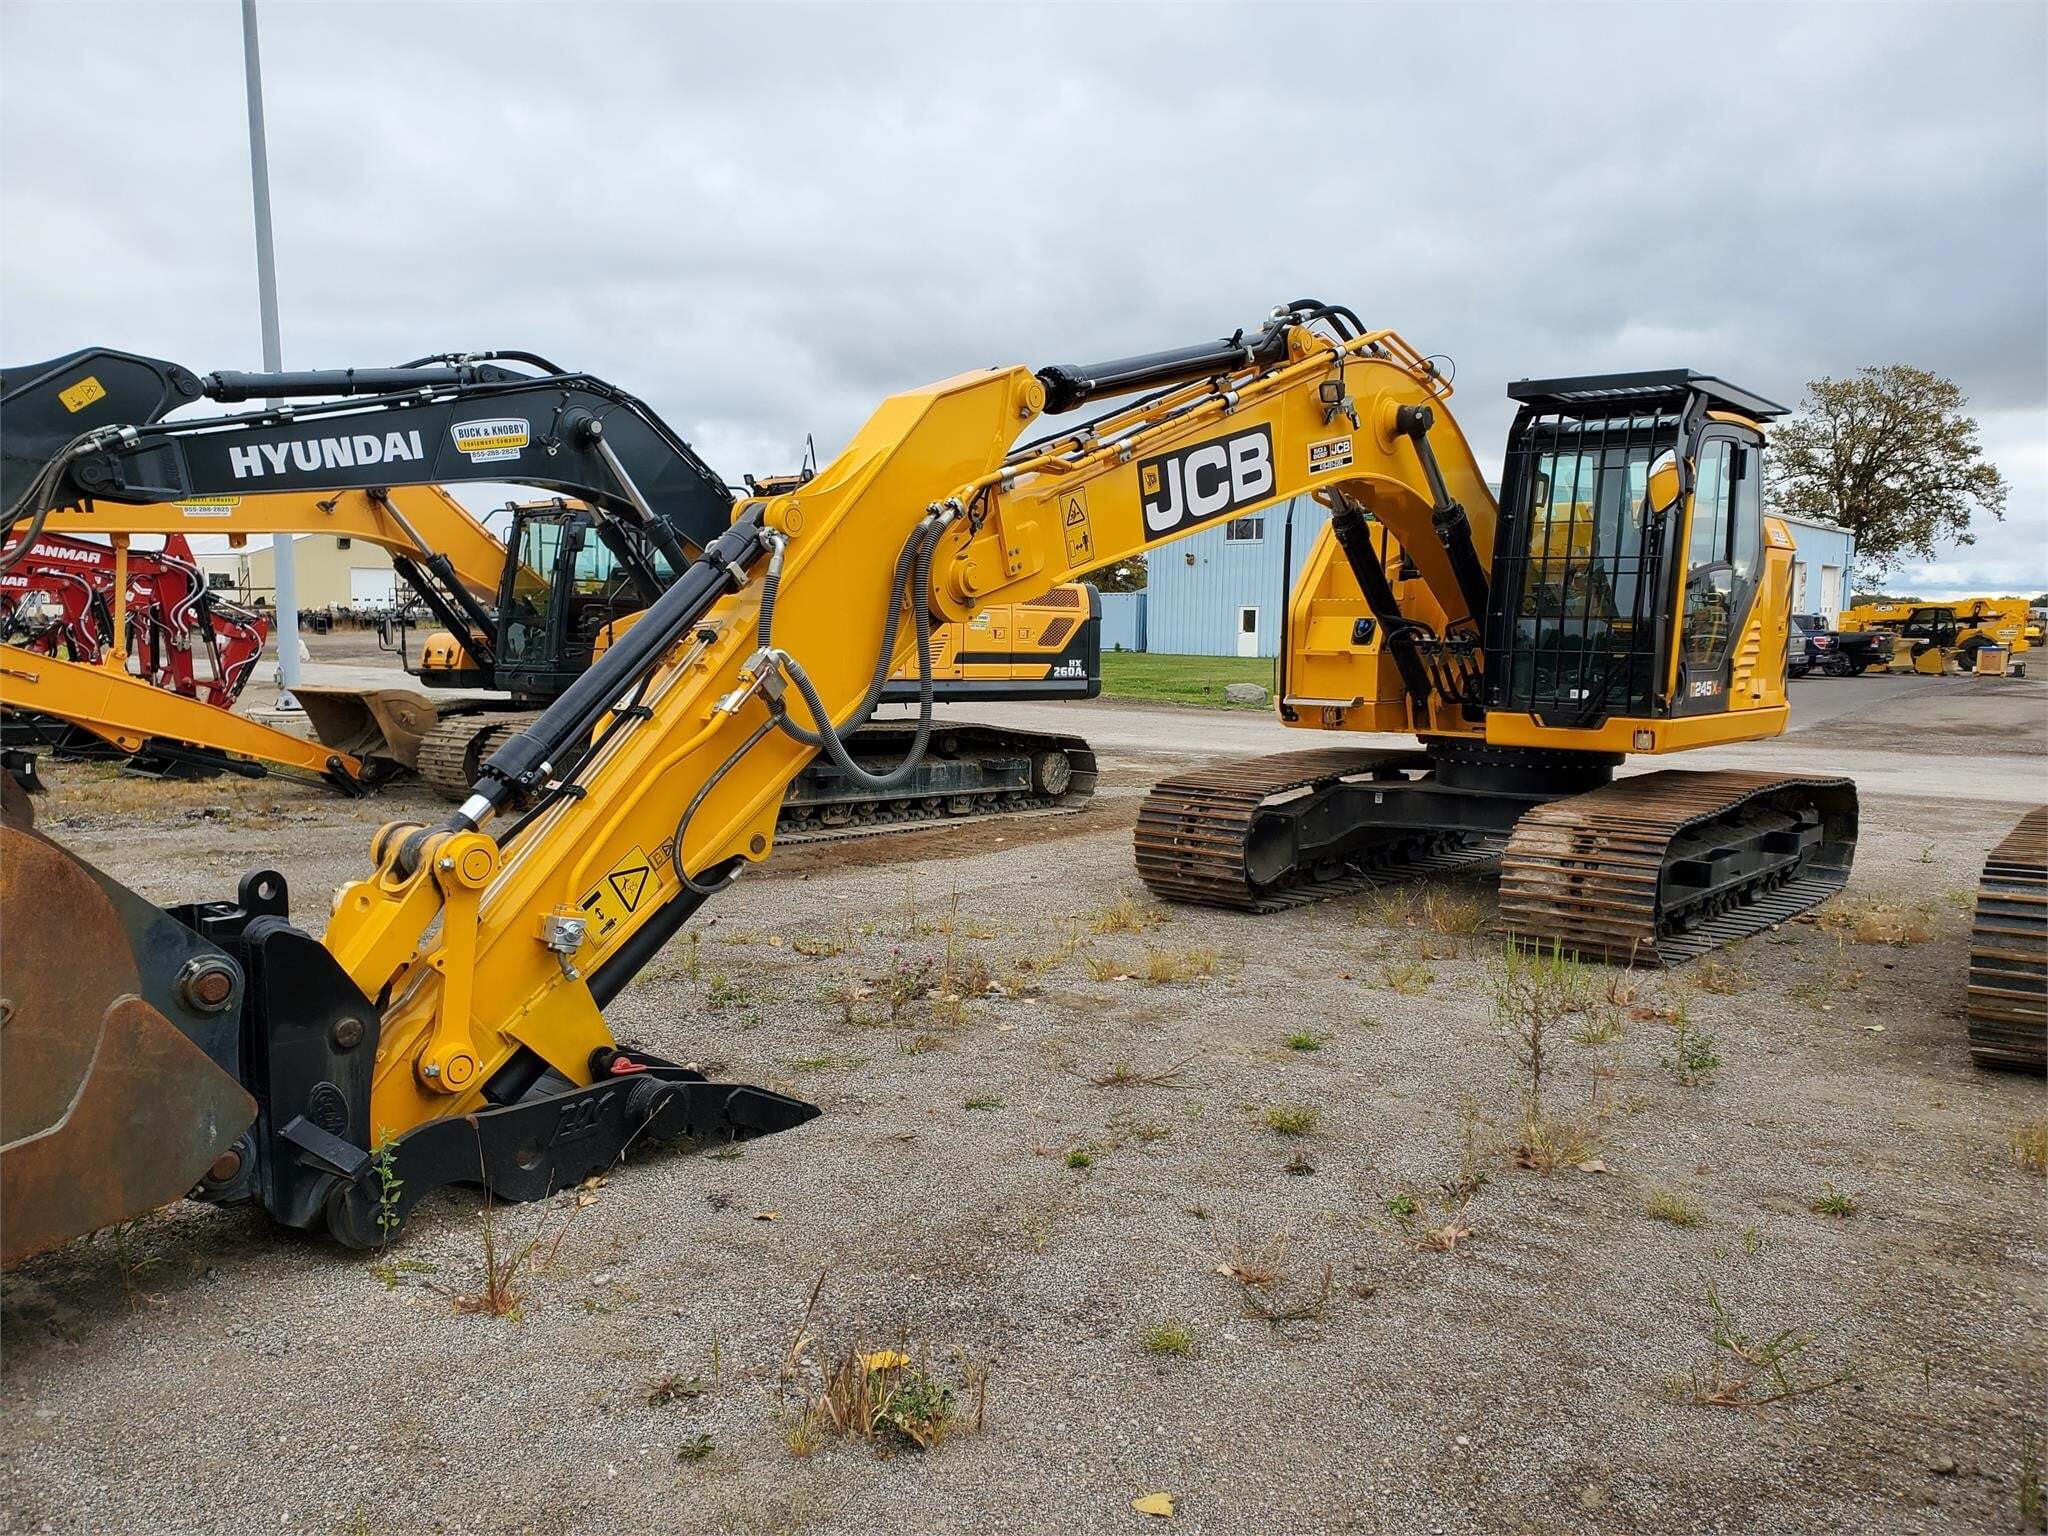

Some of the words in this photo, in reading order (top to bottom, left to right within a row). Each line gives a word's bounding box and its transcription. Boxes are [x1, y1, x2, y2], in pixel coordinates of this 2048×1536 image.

[458, 427, 481, 439] BUCK
[483, 428, 490, 437] &
[492, 424, 524, 436] KNOBBY
[229, 430, 424, 479] HYUNDAI
[1331, 441, 1350, 455] JCB
[1145, 432, 1273, 532] JCB
[30, 543, 101, 564] ANMAR
